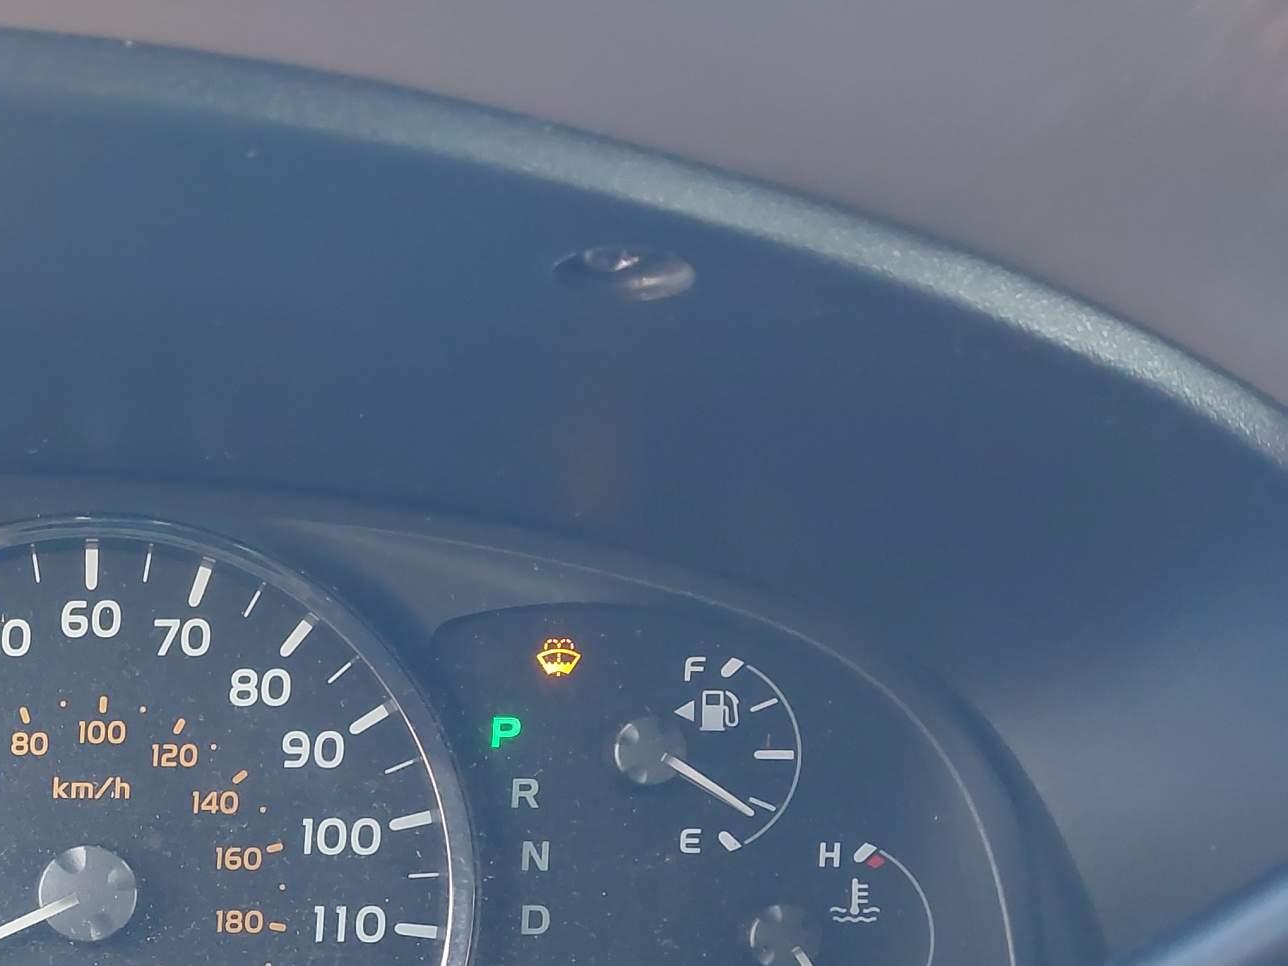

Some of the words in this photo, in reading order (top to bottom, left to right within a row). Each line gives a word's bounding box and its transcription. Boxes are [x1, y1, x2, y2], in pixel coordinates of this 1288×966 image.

[61, 599, 122, 638] 60
[154, 618, 211, 657] 70
[684, 656, 707, 682] F
[229, 668, 291, 707] 80
[11, 732, 49, 756] 80
[78, 720, 126, 744] 100
[490, 716, 522, 748] P
[152, 743, 198, 768] 120
[282, 730, 345, 769] 90
[52, 776, 130, 799] km/h
[511, 778, 539, 809] R
[192, 791, 239, 814] 140
[302, 817, 381, 856] 100
[679, 828, 702, 854] E
[215, 847, 262, 871] 160
[521, 840, 550, 871] N
[818, 842, 841, 868] H
[216, 910, 264, 934] 180
[314, 905, 386, 943] 110
[521, 904, 551, 935] D
